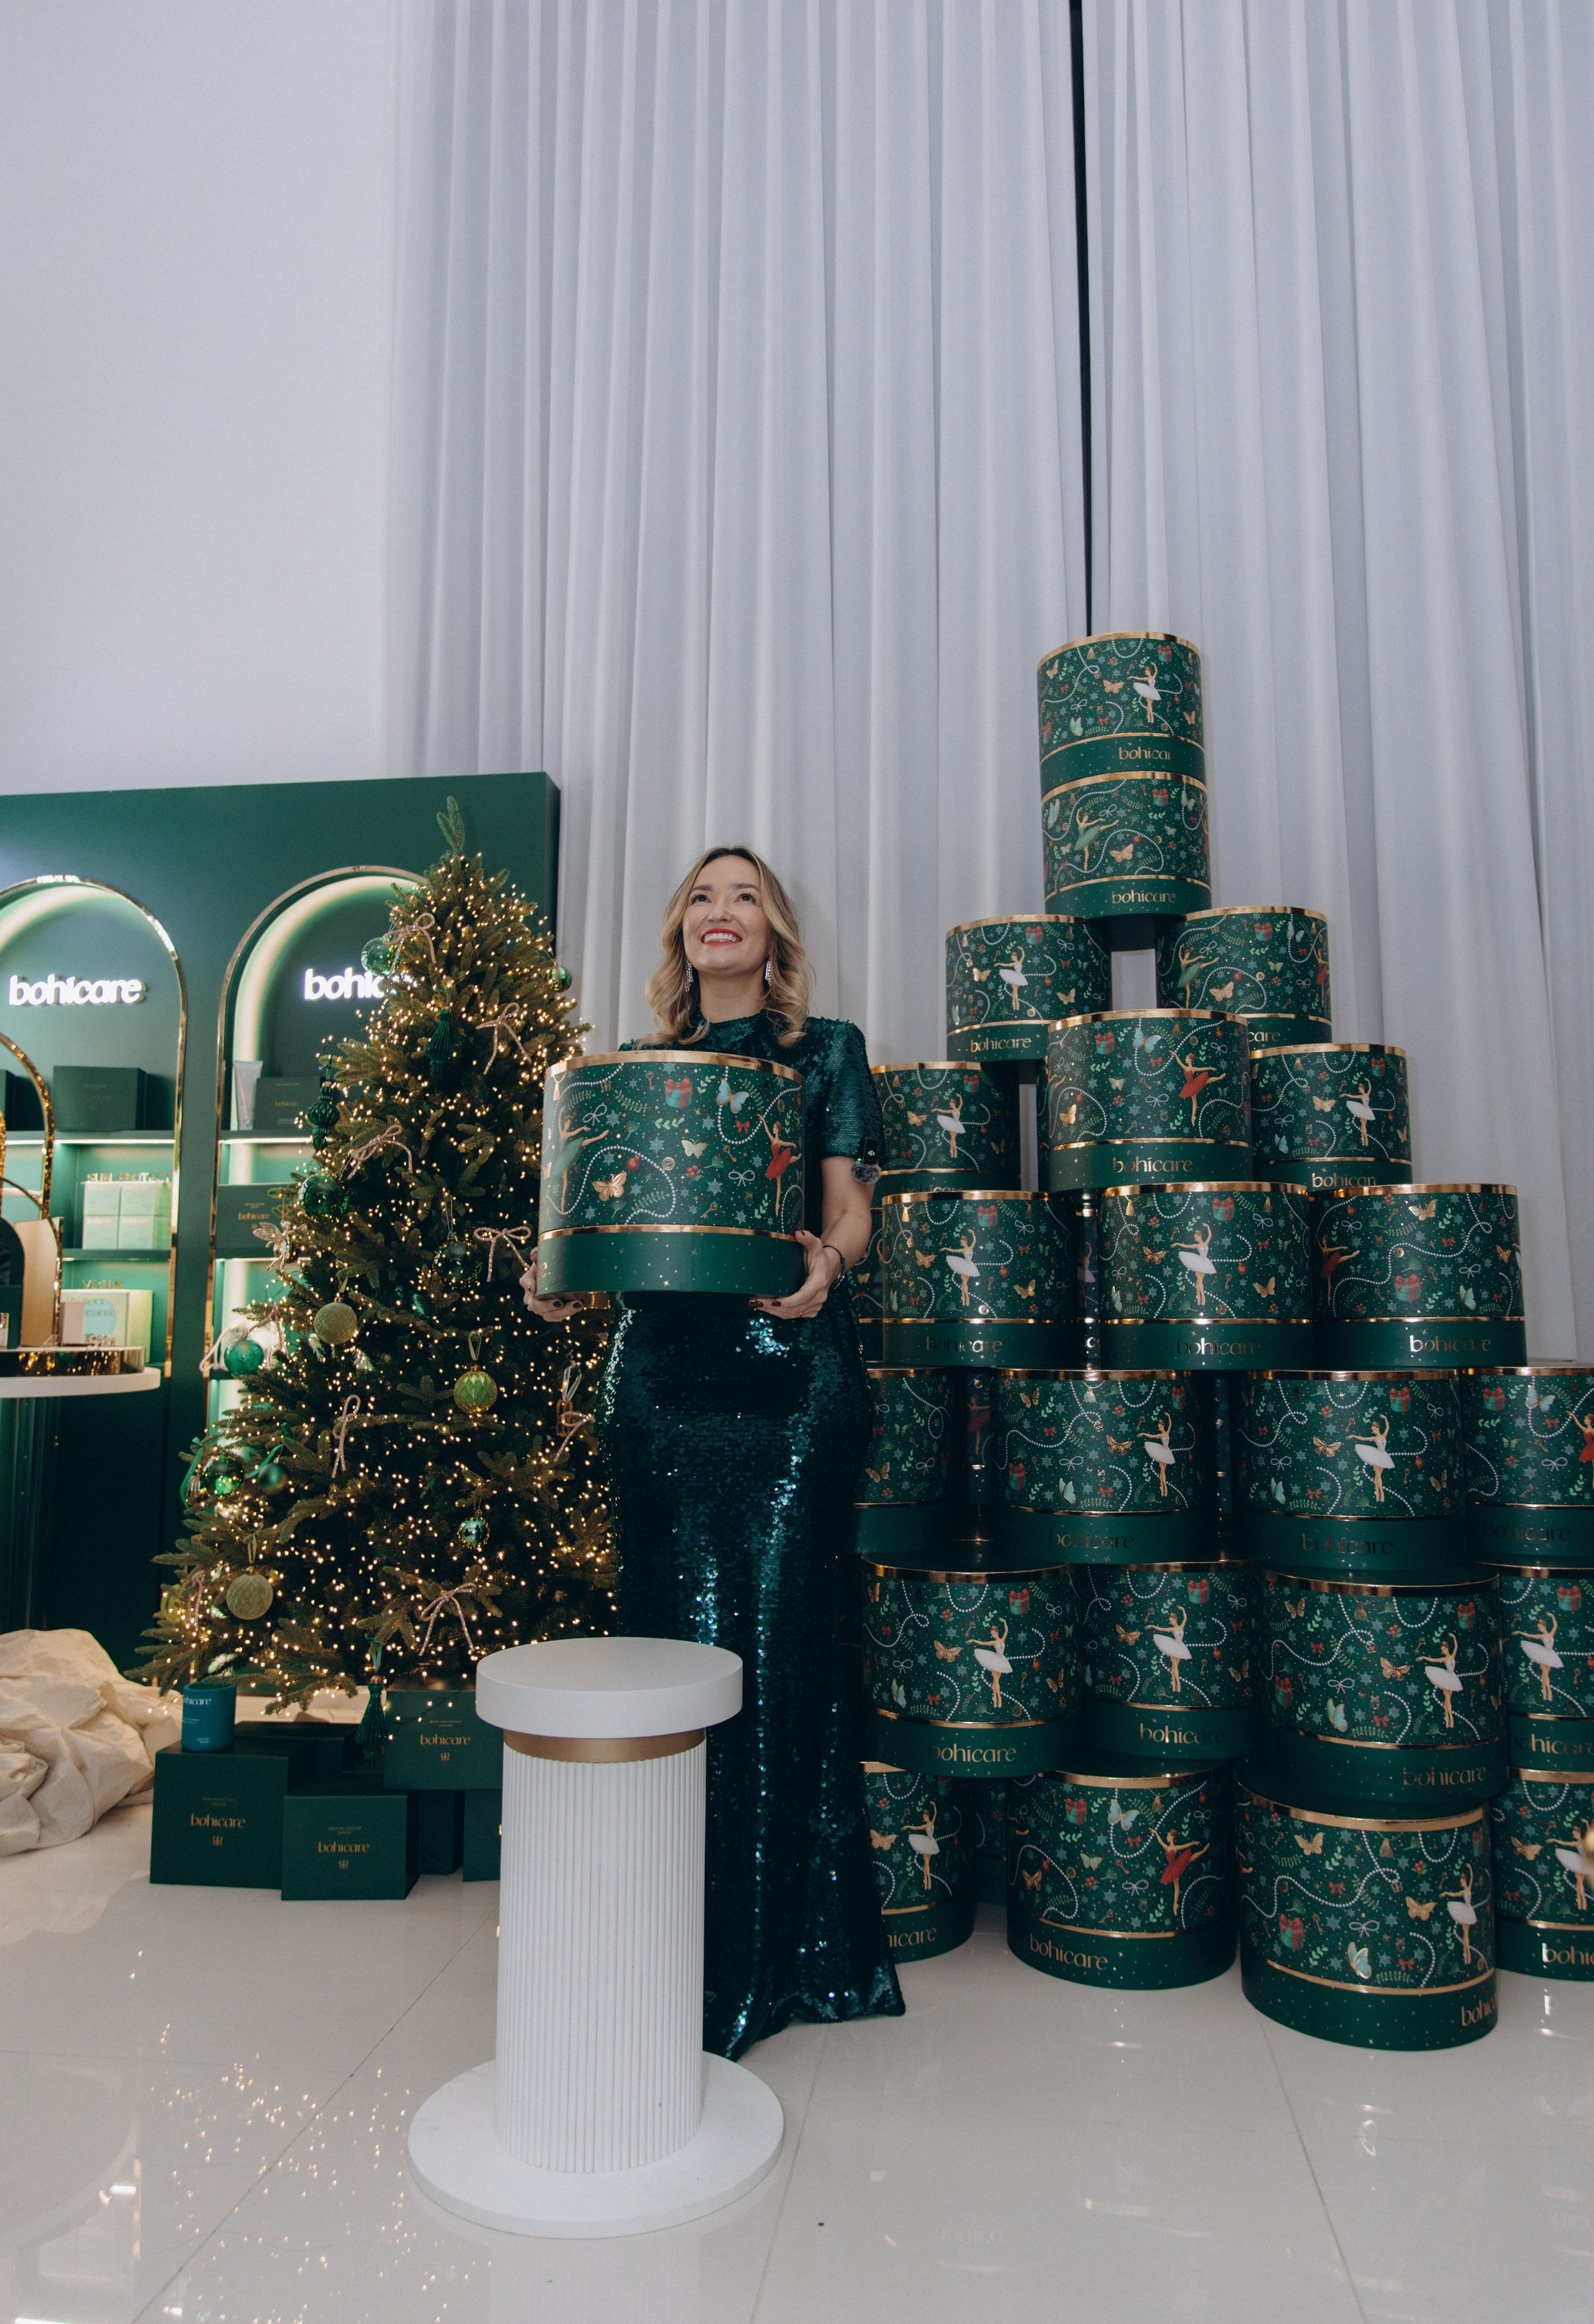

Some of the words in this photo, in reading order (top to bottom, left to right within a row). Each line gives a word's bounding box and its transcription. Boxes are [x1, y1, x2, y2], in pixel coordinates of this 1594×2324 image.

[1118, 746, 1173, 760] bohicar
[1111, 890, 1176, 904] bohicare
[9, 974, 147, 1005] bohicare
[971, 1037, 1031, 1052] bohicare
[1112, 1155, 1194, 1173] bohicare
[82, 1279, 123, 1289] VEGAN
[925, 1336, 1003, 1353] bohicare
[1176, 1337, 1261, 1355] bohicare
[1410, 1334, 1493, 1353] bohicare
[1049, 1531, 1135, 1549] bohicare
[1482, 1523, 1572, 1541] bohicare
[1301, 1533, 1394, 1555] bohicare
[420, 1734, 471, 1745] bohicare
[930, 1742, 1017, 1763] bohicare
[1402, 1765, 1487, 1787] bohicare
[191, 1813, 246, 1828] bohicare
[318, 1841, 370, 1853] bohicare
[1030, 1933, 1108, 1972] bohicare
